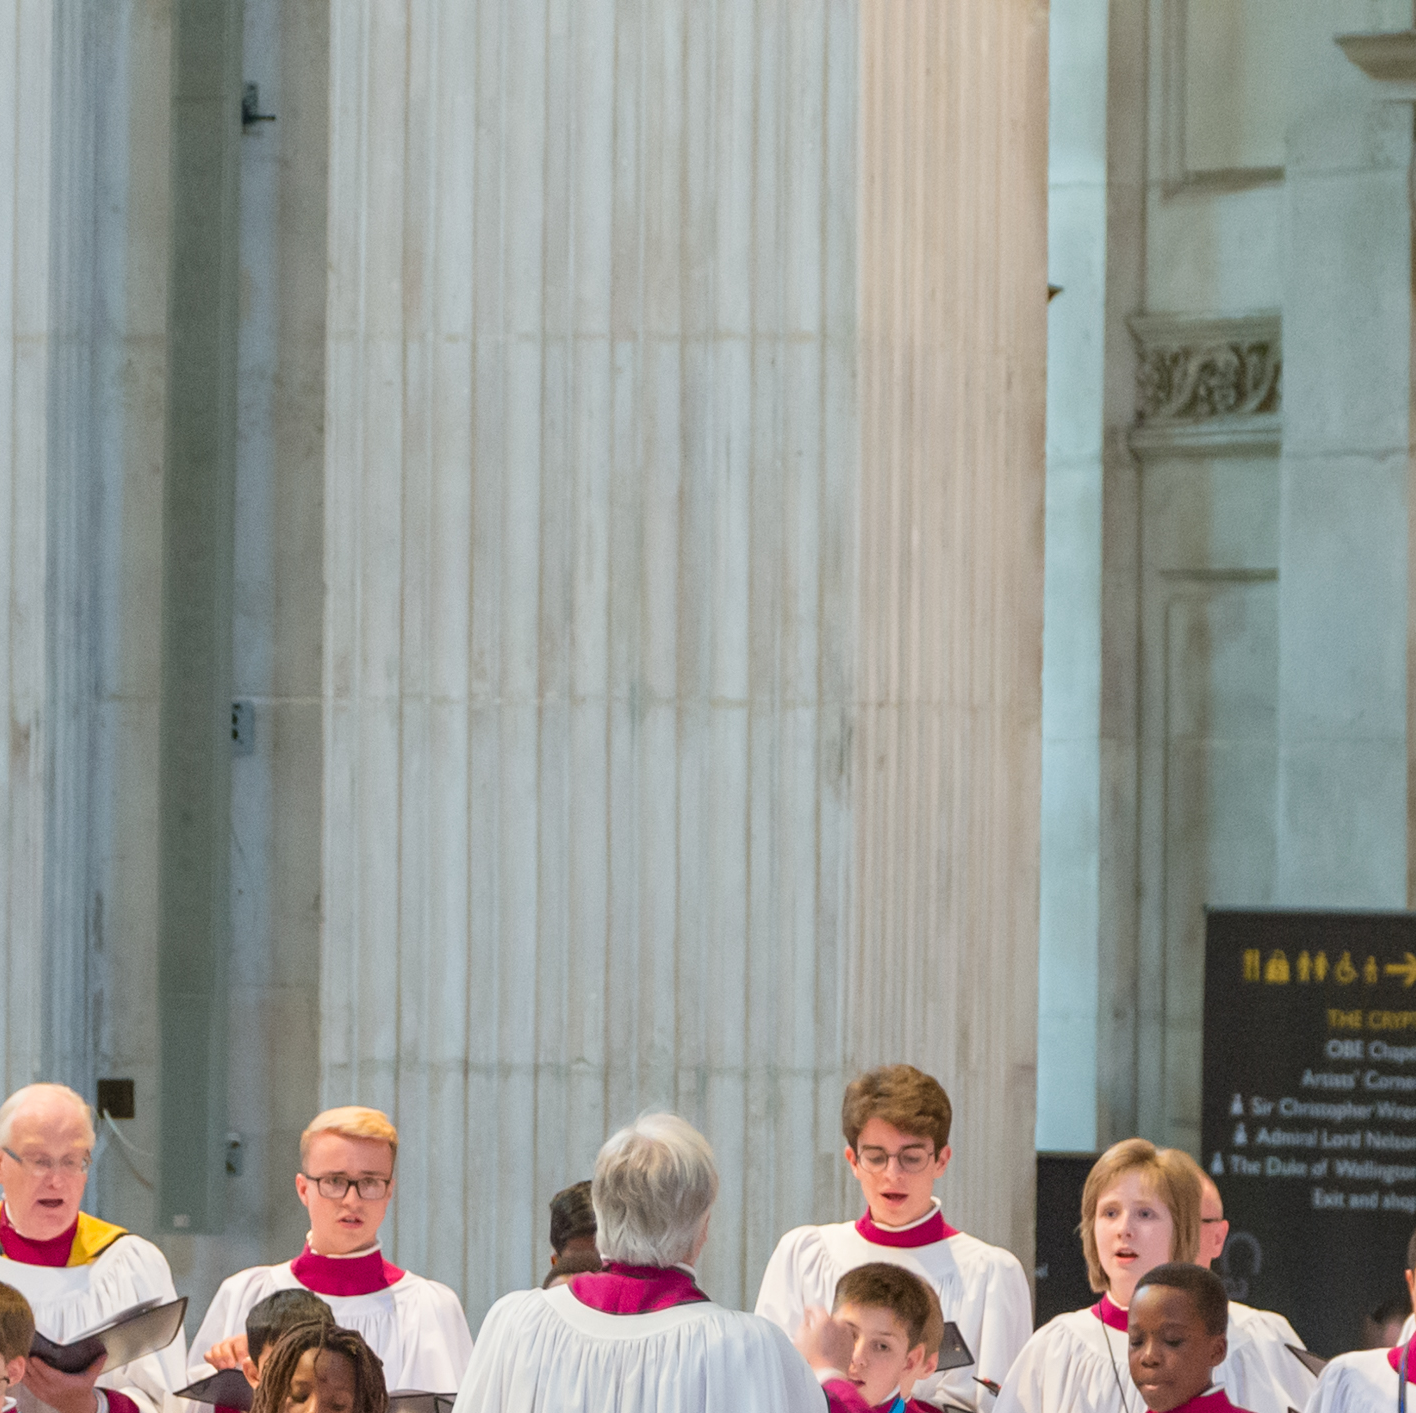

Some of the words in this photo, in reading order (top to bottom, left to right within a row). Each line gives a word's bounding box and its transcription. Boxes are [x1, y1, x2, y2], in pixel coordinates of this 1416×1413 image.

[1328, 1009, 1362, 1029] THE
[1326, 1040, 1363, 1058] OBE
[1252, 1097, 1273, 1115] Sir
[1278, 1097, 1375, 1121] Christopher
[1256, 1128, 1317, 1147] Admiral
[1321, 1129, 1361, 1148] Lord
[1231, 1155, 1261, 1174] The
[1265, 1156, 1307, 1176] Duke
[1311, 1159, 1328, 1177] of
[1313, 1188, 1344, 1207] Exit
[1349, 1191, 1378, 1208] and
